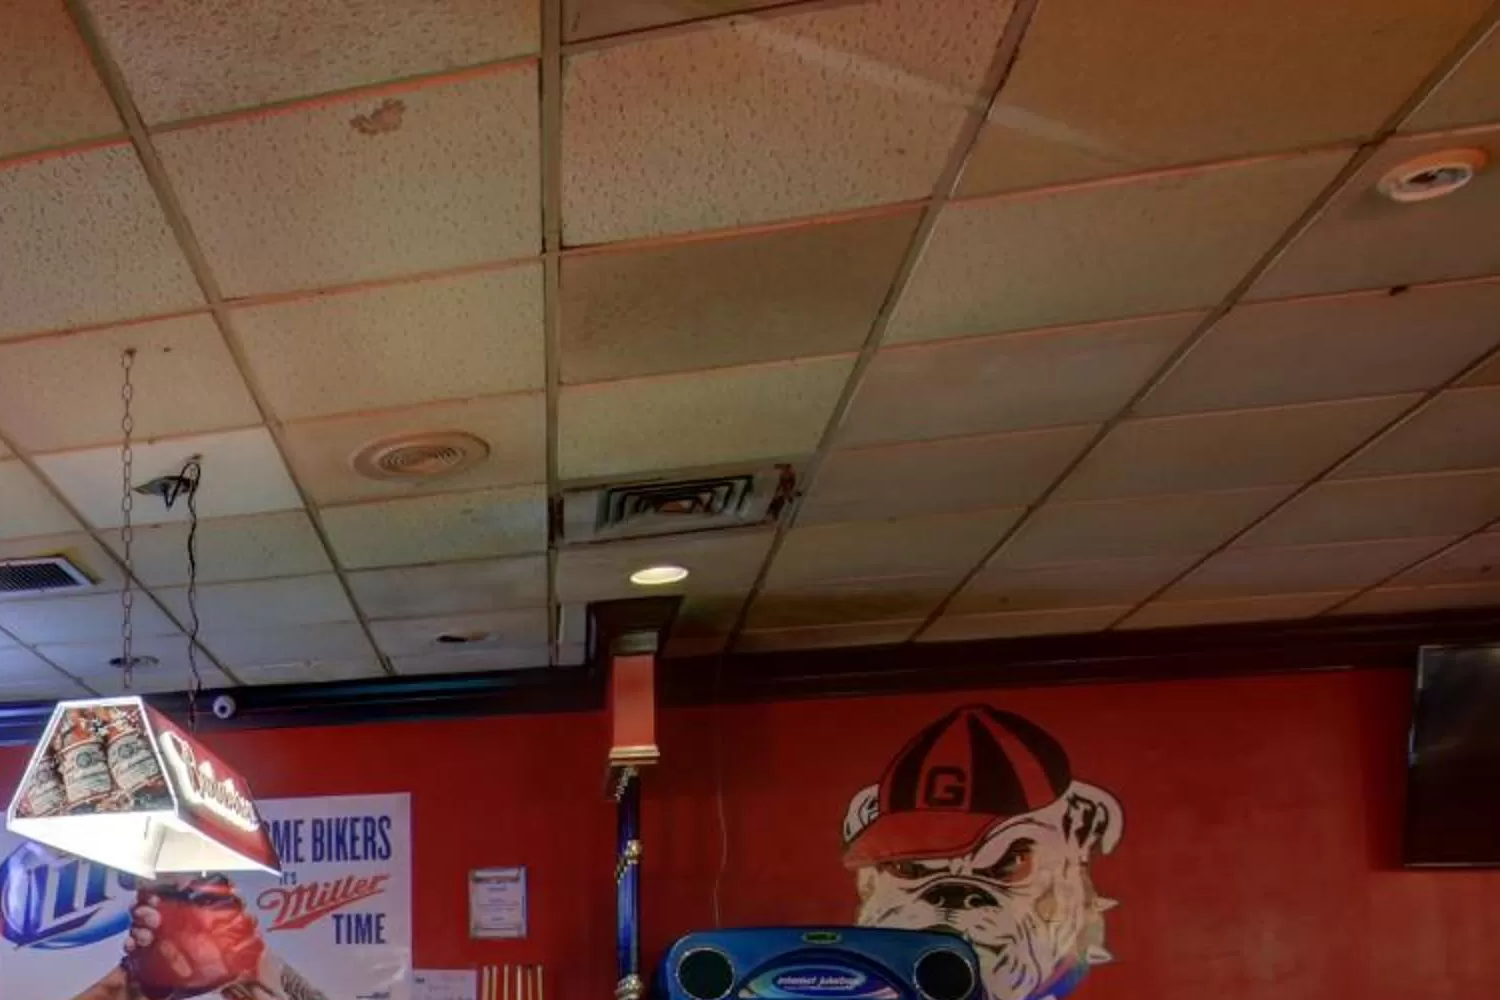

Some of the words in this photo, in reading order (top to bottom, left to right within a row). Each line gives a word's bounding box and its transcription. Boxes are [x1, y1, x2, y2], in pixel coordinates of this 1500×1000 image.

[925, 766, 967, 809] G
[311, 815, 392, 862] BIKERS
[256, 873, 390, 931] Miller
[332, 911, 387, 945] TIME
